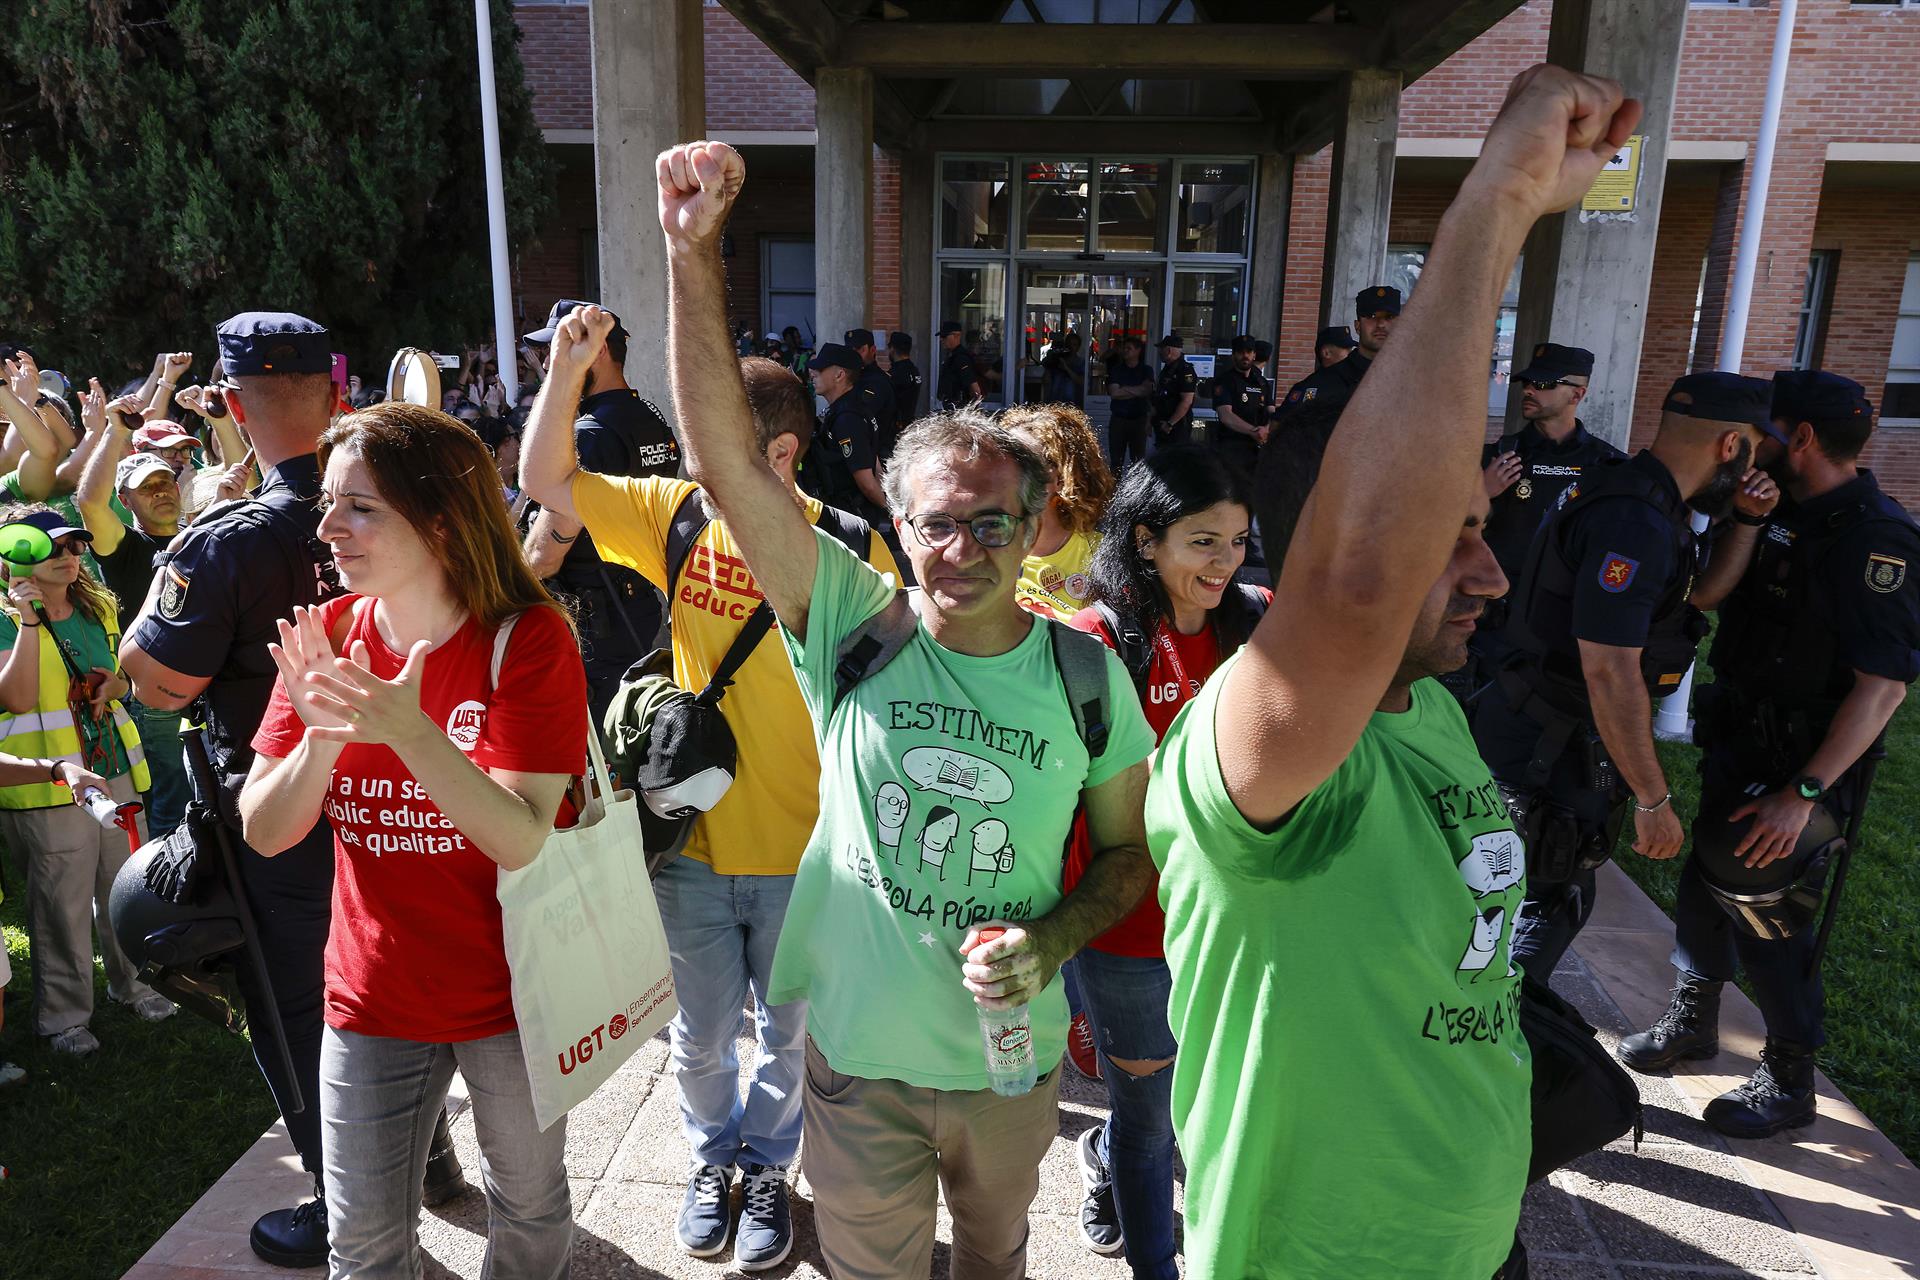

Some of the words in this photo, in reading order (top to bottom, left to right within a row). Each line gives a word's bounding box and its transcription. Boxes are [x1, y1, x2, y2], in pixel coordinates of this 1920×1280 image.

[639, 443, 669, 456] POLIC
[641, 452, 677, 467] NACIOL
[690, 552, 762, 593] CCO
[1161, 634, 1175, 653] UGT
[1150, 682, 1180, 704] UG
[453, 709, 486, 729] UGT
[887, 700, 1050, 771] ESTIMEM
[339, 776, 353, 796] a
[361, 778, 393, 799] un
[323, 796, 372, 825] úblic
[340, 825, 363, 847] de
[366, 832, 467, 858] qualitat
[846, 842, 935, 921] L'ESCOLA
[557, 1023, 605, 1076] UGT
